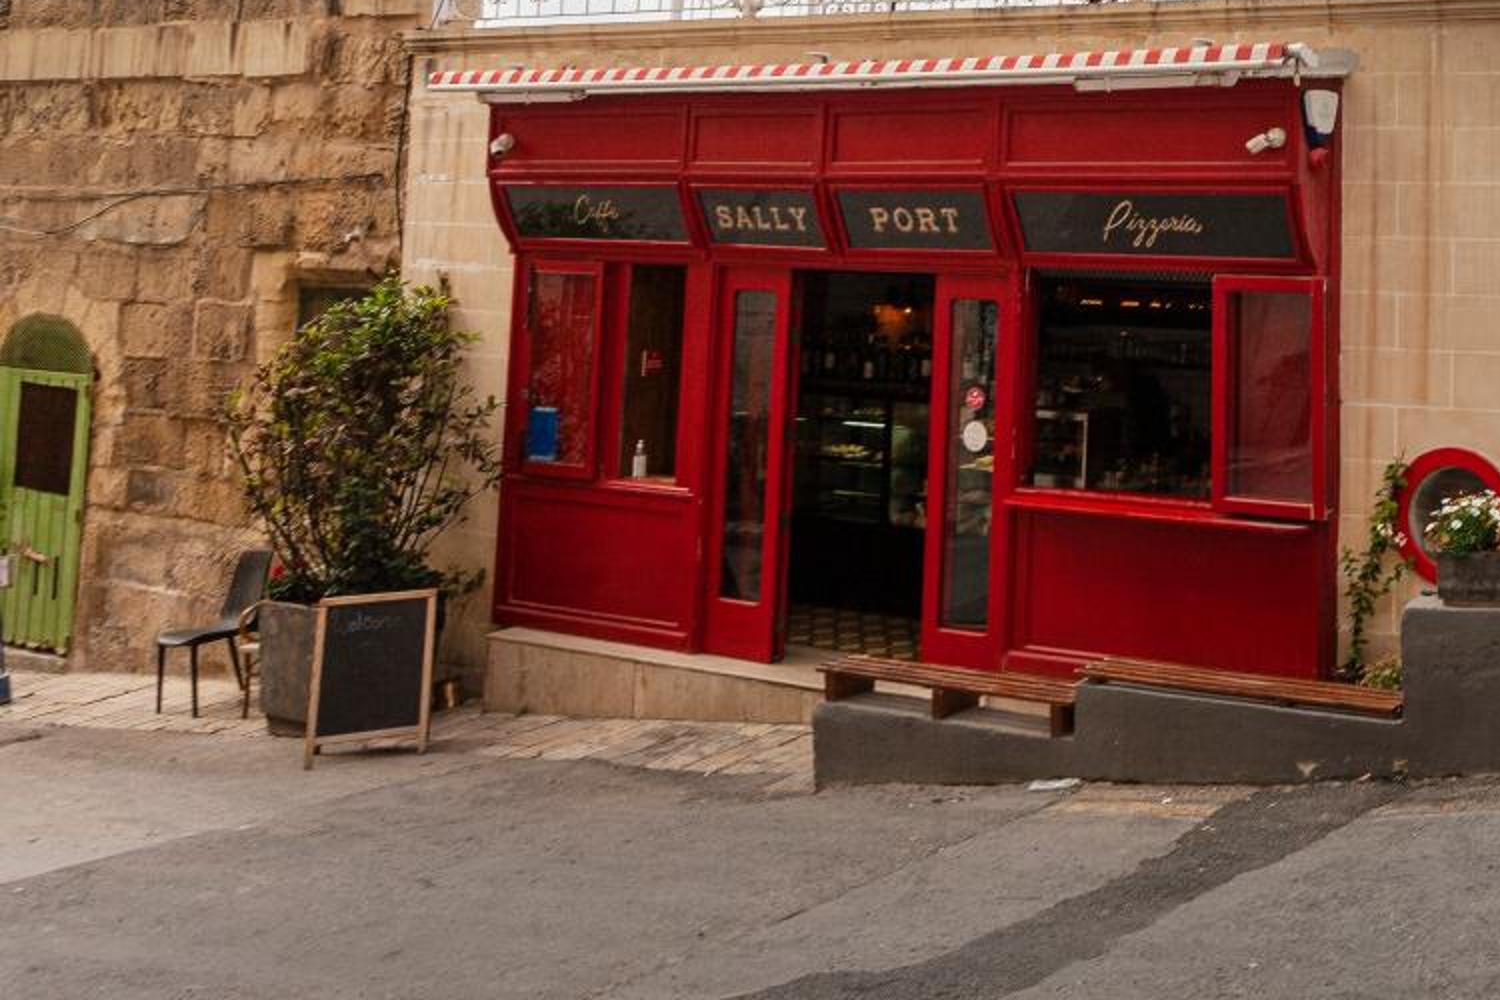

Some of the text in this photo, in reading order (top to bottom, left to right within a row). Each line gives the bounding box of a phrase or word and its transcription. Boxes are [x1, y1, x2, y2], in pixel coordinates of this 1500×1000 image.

[715, 204, 958, 232] SALLY PORT
[1103, 200, 1203, 248] Pizzeria
